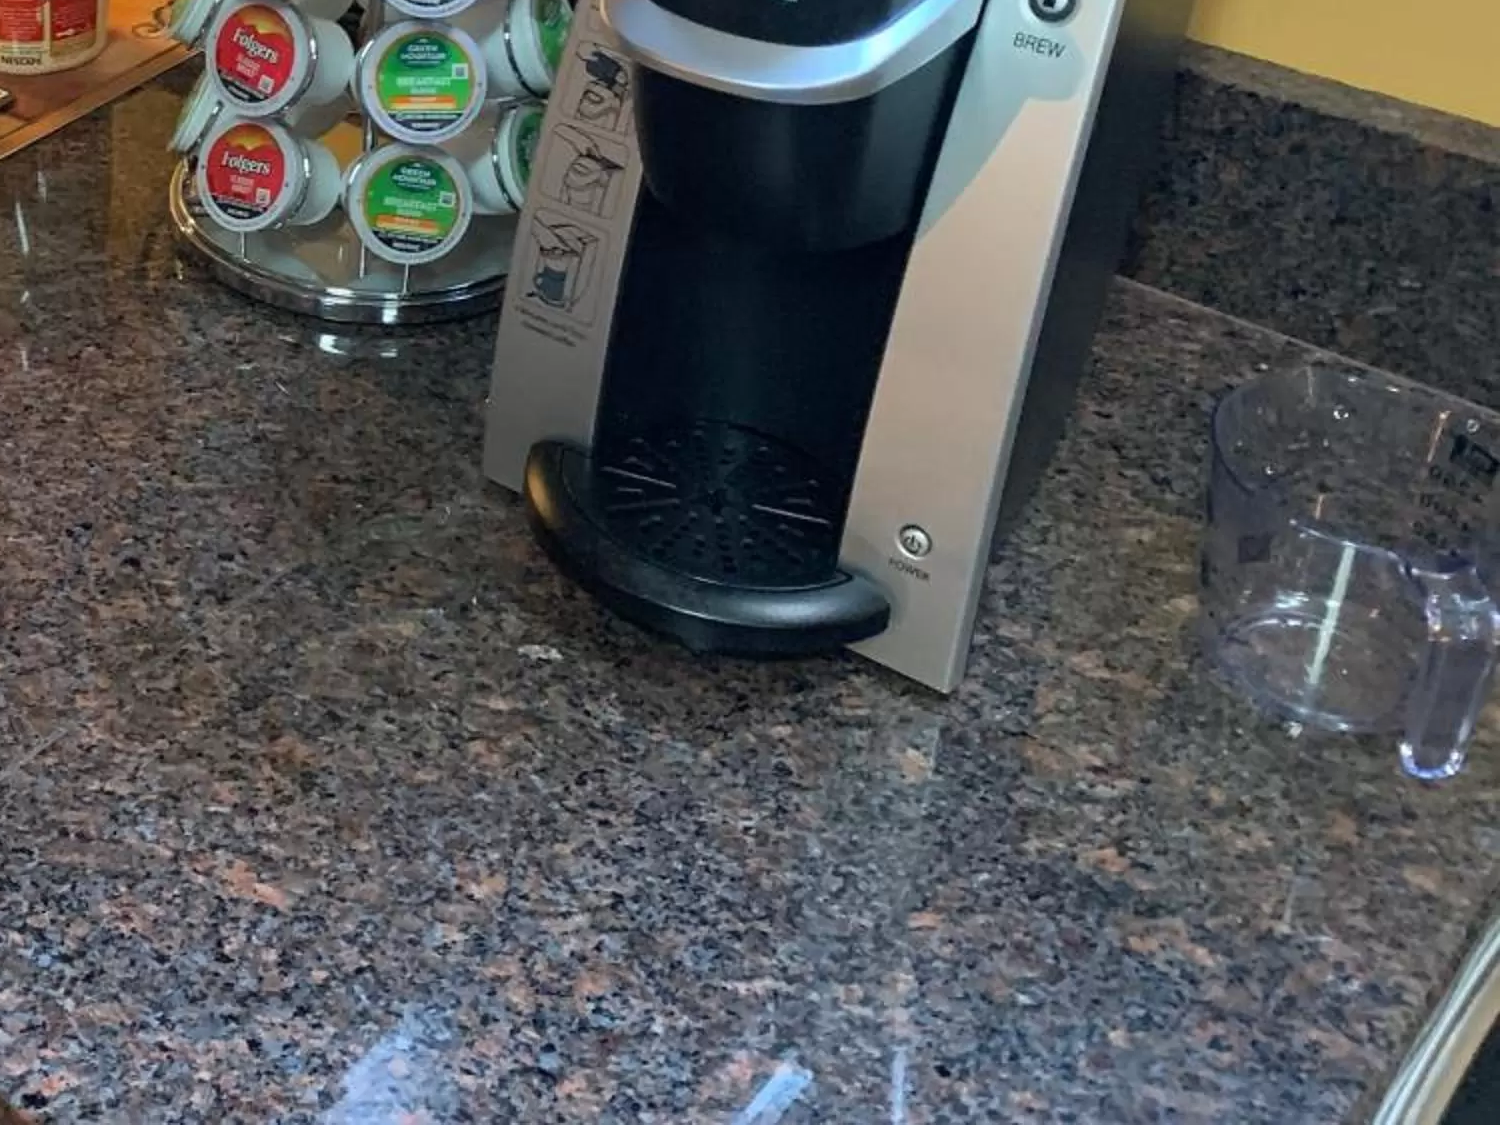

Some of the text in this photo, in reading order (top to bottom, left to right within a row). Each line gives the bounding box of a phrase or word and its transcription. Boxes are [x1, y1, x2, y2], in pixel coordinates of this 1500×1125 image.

[233, 27, 278, 64] Folgers
[1013, 32, 1066, 58] BREW
[221, 151, 272, 176] Folgers
[888, 557, 931, 581] POWER
